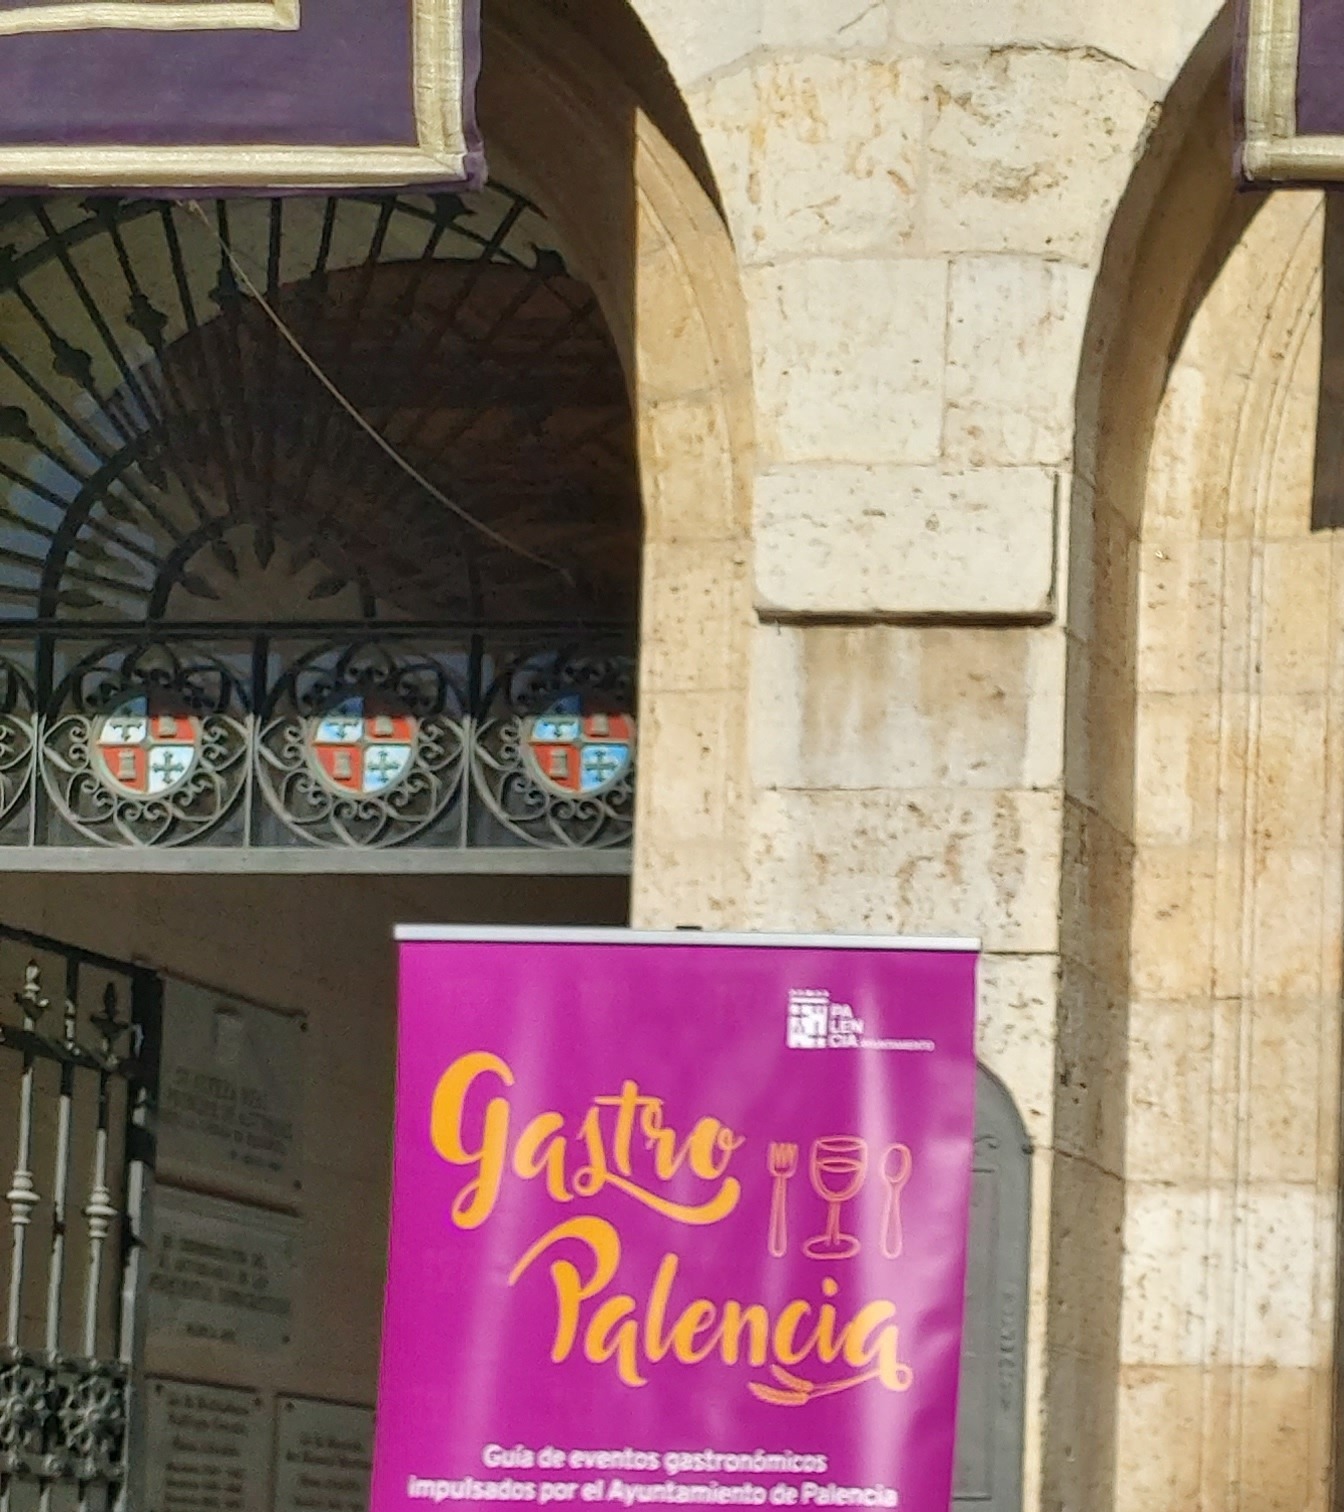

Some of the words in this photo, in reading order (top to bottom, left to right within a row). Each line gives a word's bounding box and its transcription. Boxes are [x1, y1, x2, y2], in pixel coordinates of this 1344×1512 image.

[507, 1215, 913, 1400] Palencia
[482, 1443, 534, 1469] Guía
[537, 1446, 566, 1469] de
[569, 1447, 661, 1471] eventos
[664, 1449, 829, 1475] gastronómicos
[541, 1482, 578, 1504] por
[582, 1480, 605, 1501] el
[608, 1480, 767, 1507] Ayuntamiento
[770, 1482, 798, 1505] de
[800, 1482, 898, 1507] Palencia
